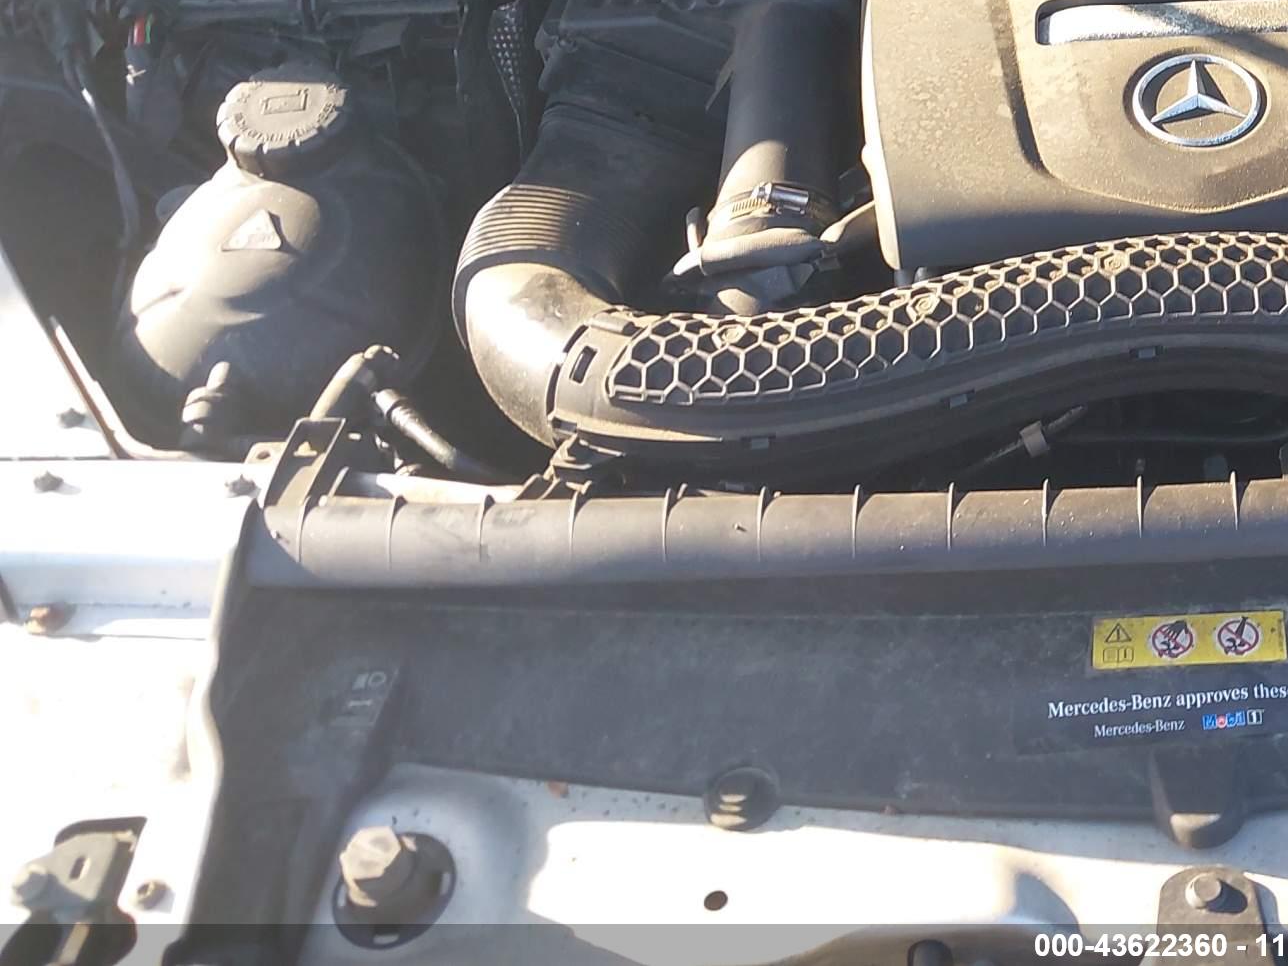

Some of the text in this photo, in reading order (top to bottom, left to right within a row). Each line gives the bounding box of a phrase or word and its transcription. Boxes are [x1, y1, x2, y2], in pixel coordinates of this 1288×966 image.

[1047, 694, 1172, 719] Mercedes-Benz
[1176, 686, 1249, 710] approves
[1094, 719, 1186, 738] Mercedes-Benz
